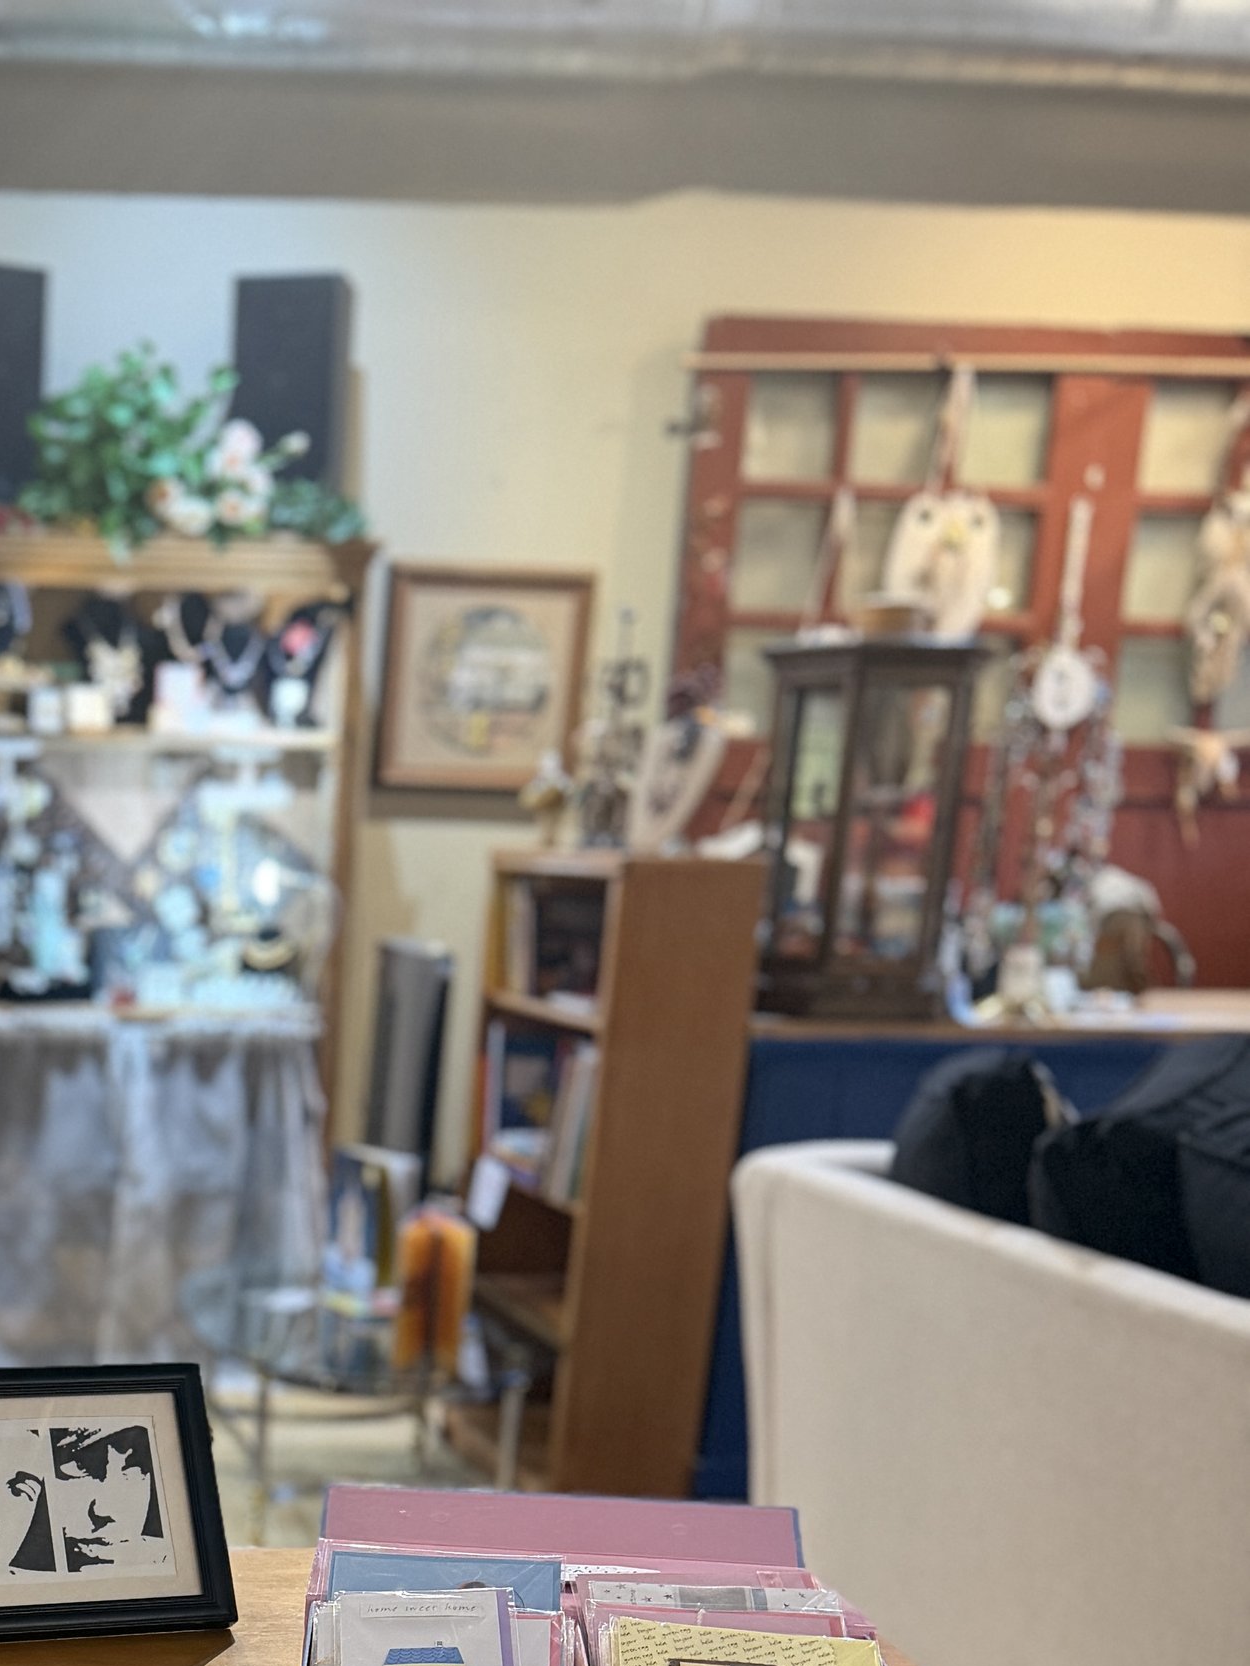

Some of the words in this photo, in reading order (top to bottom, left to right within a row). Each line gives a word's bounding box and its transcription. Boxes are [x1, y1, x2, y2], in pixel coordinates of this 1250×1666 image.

[367, 1603, 398, 1612] home
[405, 1604, 437, 1612] sweet
[445, 1603, 476, 1612] home
